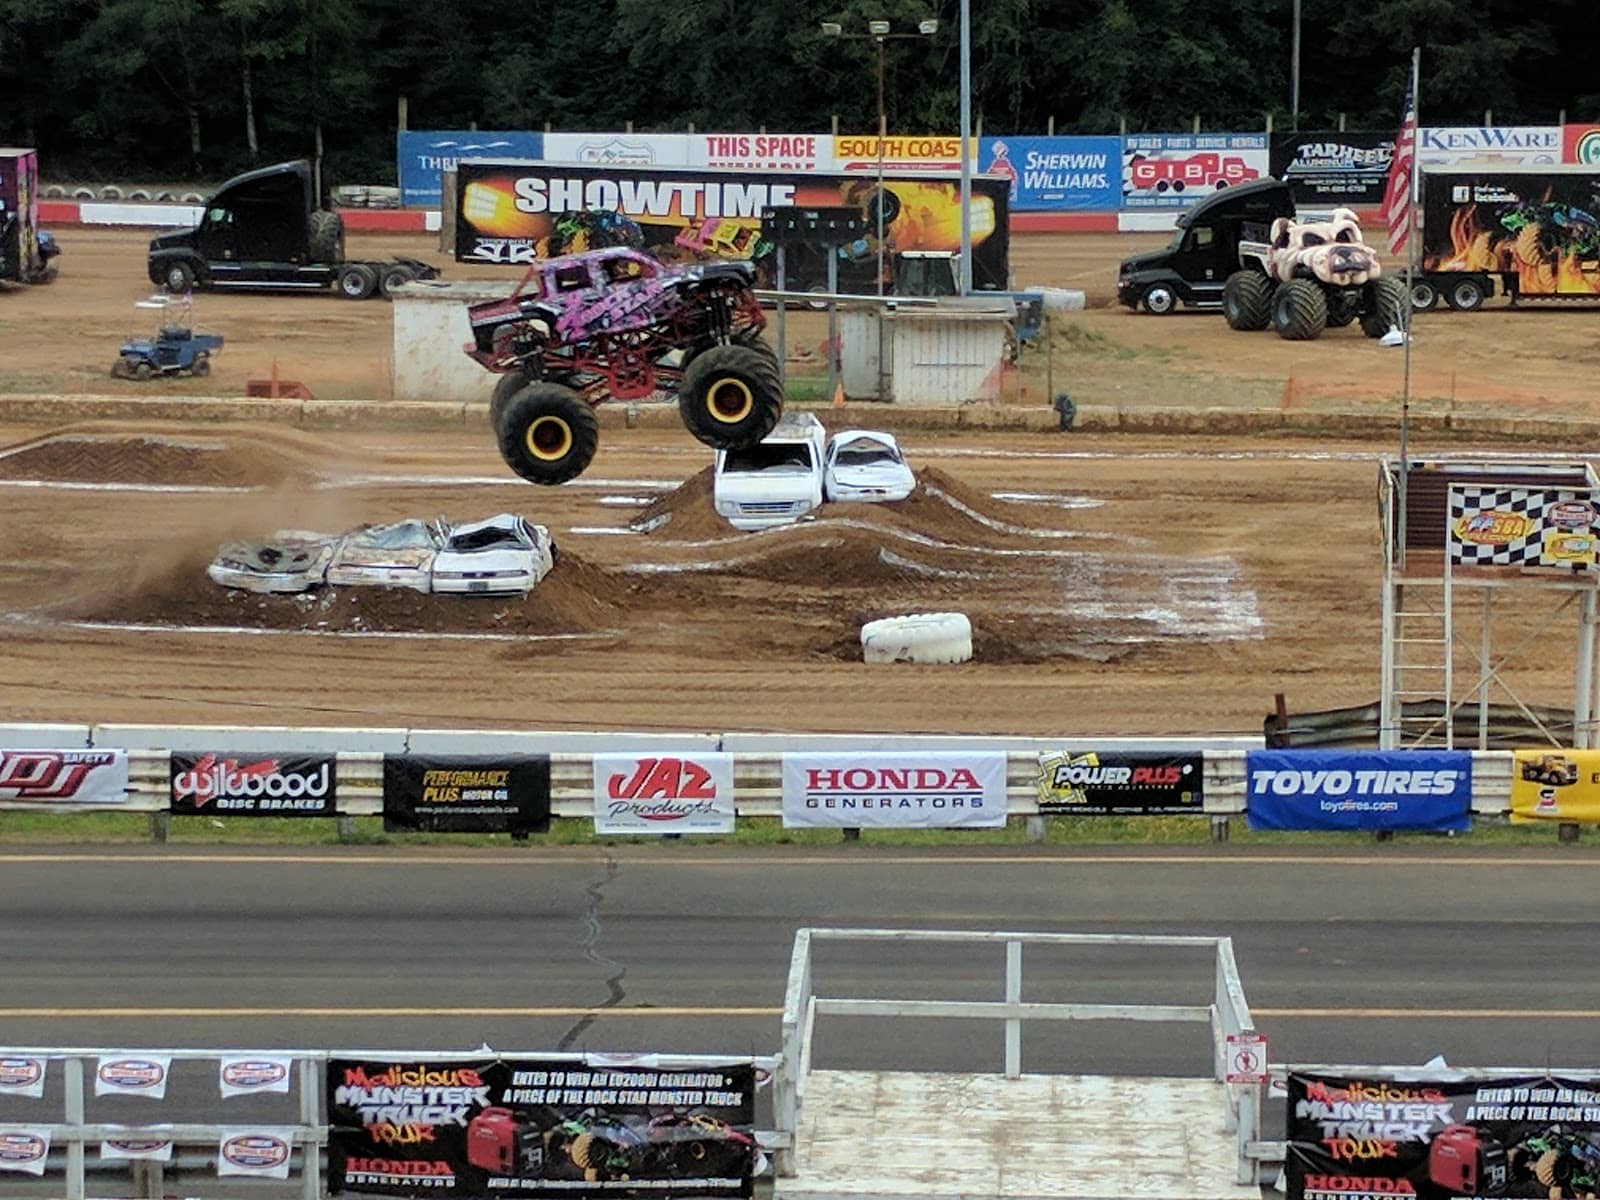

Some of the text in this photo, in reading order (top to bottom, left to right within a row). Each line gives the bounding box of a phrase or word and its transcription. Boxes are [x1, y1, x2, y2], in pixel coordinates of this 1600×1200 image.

[706, 137, 816, 158] THIS SPACE
[840, 139, 903, 157] SOUTH
[1026, 151, 1107, 171] SHERWIN
[513, 177, 797, 218] SHOWTIME
[173, 763, 329, 798] wilwood
[423, 770, 510, 787] PERFORMANCE
[607, 758, 718, 800] JAZ
[805, 769, 984, 790] HONDA
[1055, 766, 1182, 785] POWER PLUS
[1252, 771, 1458, 795] TOYO TIRES
[216, 799, 326, 809] DISC BRAKES
[423, 787, 460, 802] PLUS
[806, 797, 984, 809] GENERATORS
[608, 799, 723, 819] Products
[1320, 799, 1399, 813] toyotires.com
[512, 1071, 548, 1086] ENTER
[549, 1071, 565, 1086] TO
[566, 1072, 592, 1086] WIN
[591, 1072, 608, 1087] AN
[659, 1073, 723, 1088] GENERATOR
[502, 1088, 743, 1106] A PIECE OF THE ROCK STAR MONSTER TRUCK
[1476, 1088, 1512, 1103] ENTER
[1513, 1088, 1530, 1103] TO
[1530, 1088, 1556, 1103] WIN
[357, 1104, 470, 1128] TRUCK
[1466, 1106, 1475, 1120] A
[1477, 1106, 1510, 1120] PIECE
[1510, 1106, 1527, 1121] OF
[1527, 1106, 1549, 1121] THE
[1550, 1106, 1583, 1122] ROCK
[365, 1123, 437, 1144] TOUR
[1317, 1121, 1432, 1144] TRUCK
[1322, 1139, 1398, 1162] TOUR
[346, 1157, 454, 1174] HONDA
[345, 1175, 456, 1188] GENERATORS
[1304, 1174, 1417, 1193] HONDA
